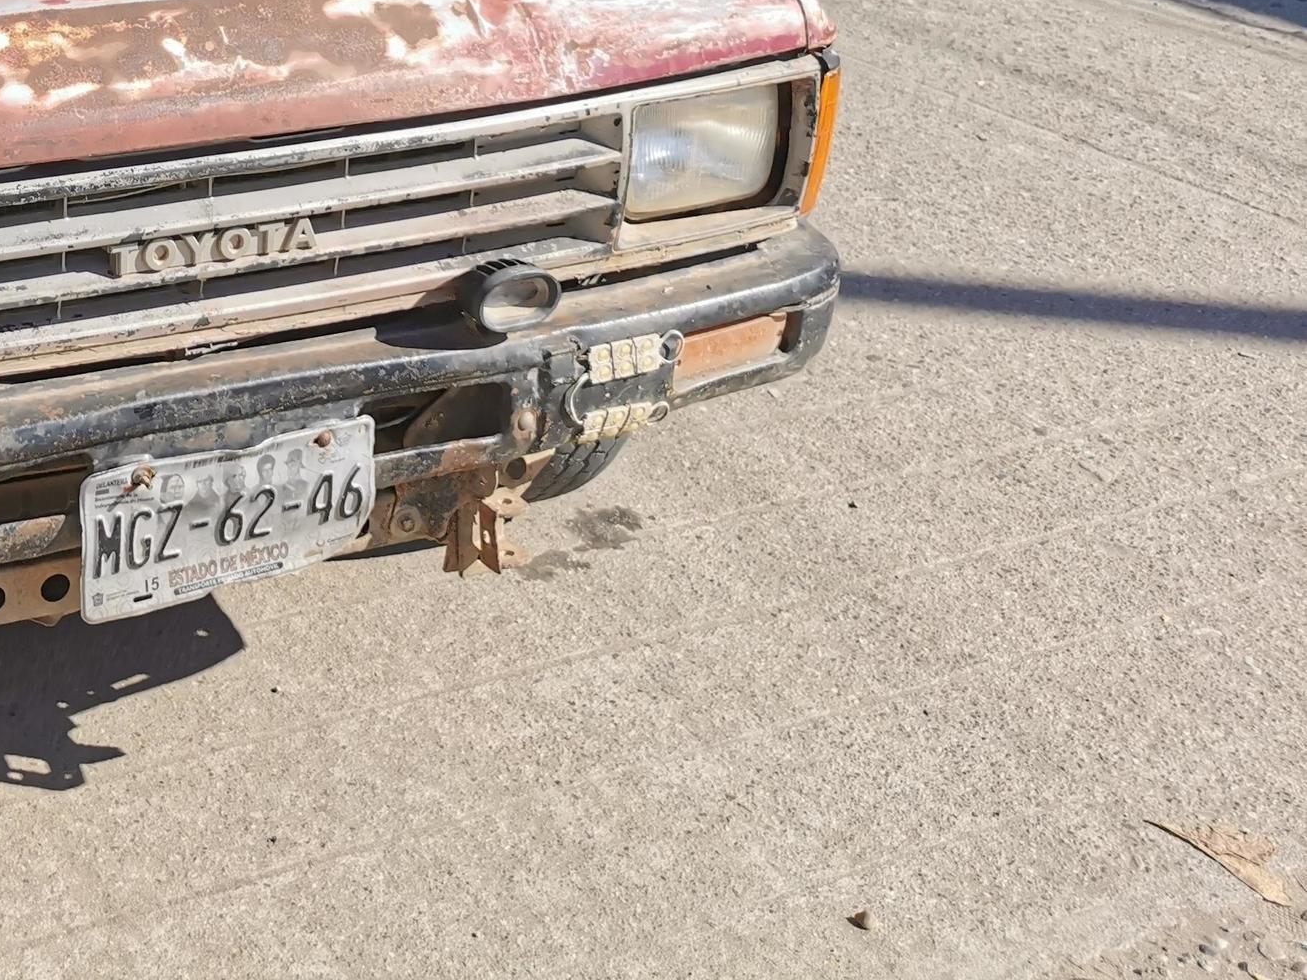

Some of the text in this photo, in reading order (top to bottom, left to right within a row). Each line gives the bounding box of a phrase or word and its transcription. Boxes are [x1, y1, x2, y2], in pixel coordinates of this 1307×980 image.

[109, 217, 317, 277] TOYOTA
[95, 465, 363, 580] MGZ-62-46
[144, 576, 160, 593] 15
[168, 541, 289, 588] ESTADO DE MÉXICO
